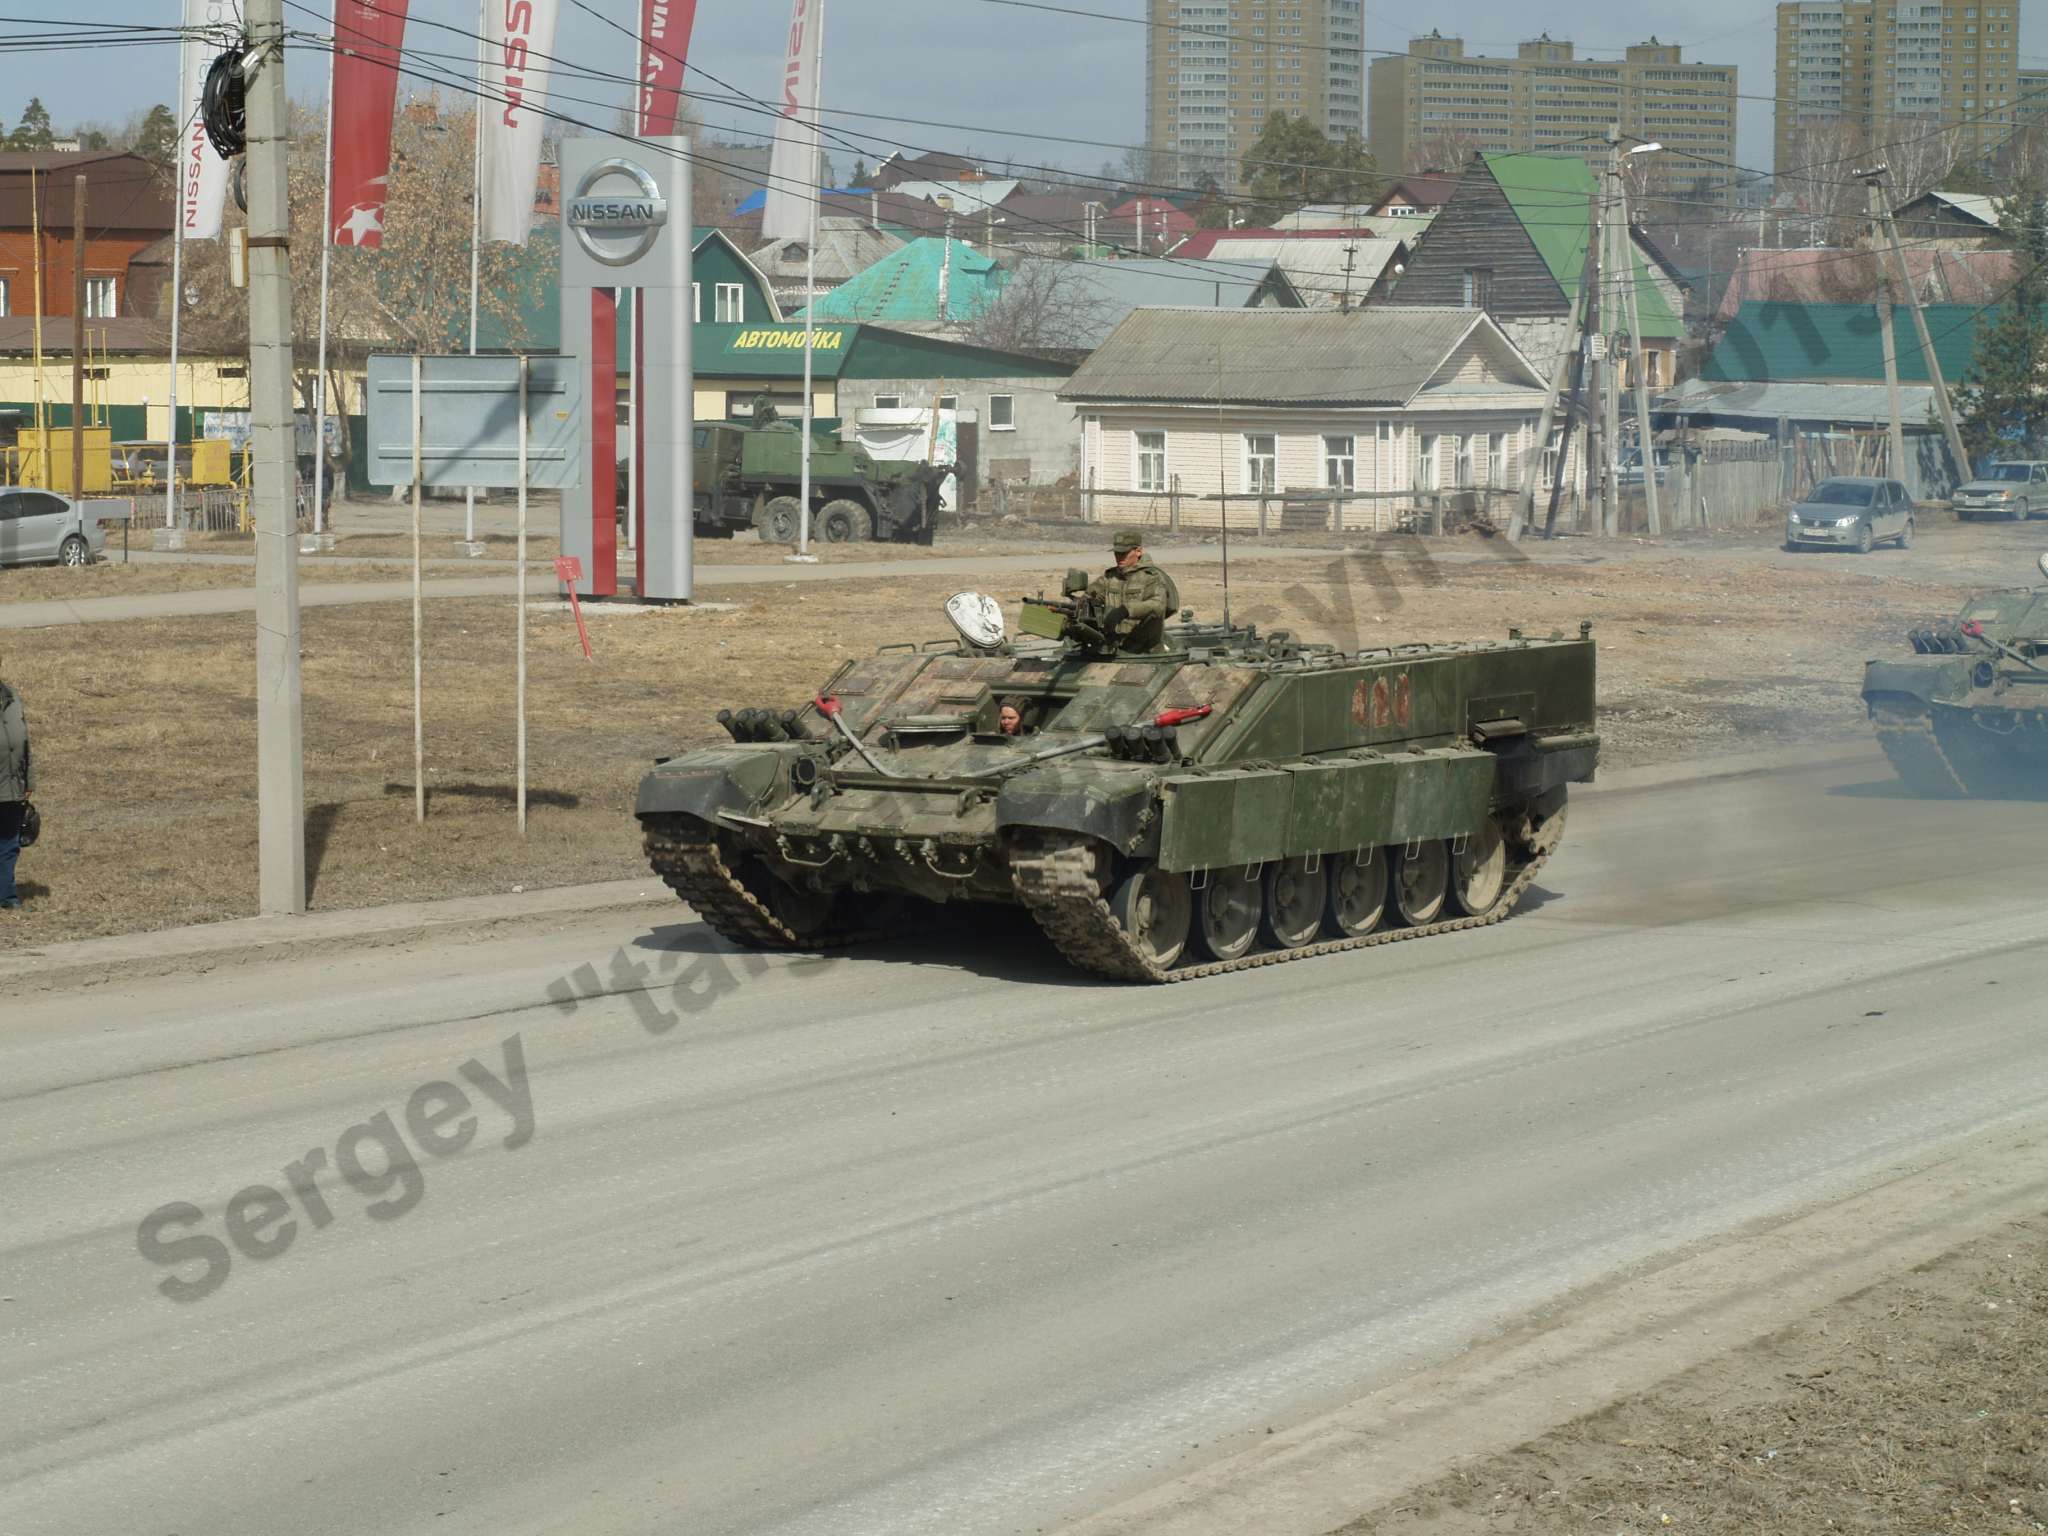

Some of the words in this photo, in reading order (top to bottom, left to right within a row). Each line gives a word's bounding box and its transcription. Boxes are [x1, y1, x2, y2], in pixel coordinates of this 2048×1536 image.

[186, 121, 206, 228] NISSAN
[572, 204, 653, 220] NISSAN
[733, 328, 842, 349] АВТОМОЙКА
